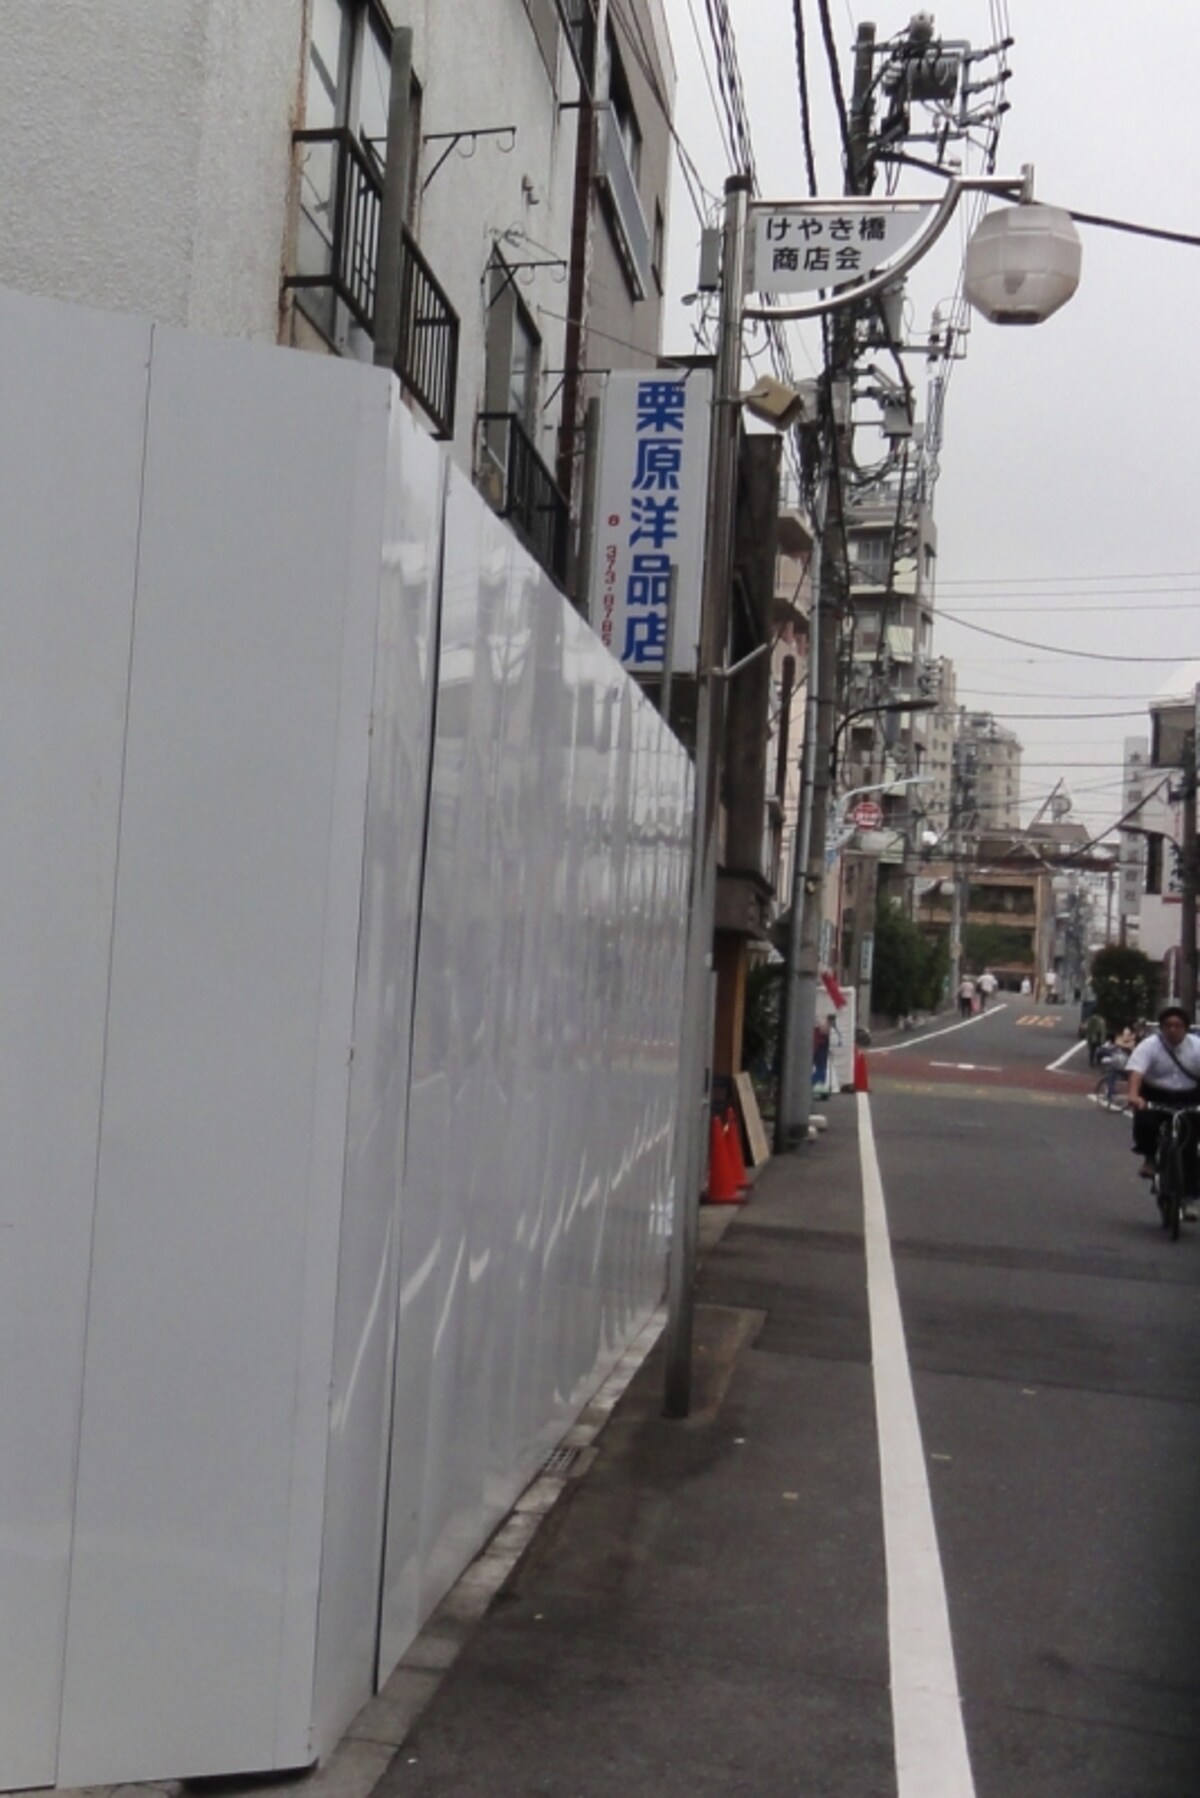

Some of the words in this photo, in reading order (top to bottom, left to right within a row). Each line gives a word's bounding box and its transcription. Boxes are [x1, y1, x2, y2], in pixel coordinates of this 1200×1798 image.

[766, 215, 886, 242] けやき橋
[772, 246, 862, 272] 商店会
[621, 381, 686, 663] 栗原洋品店
